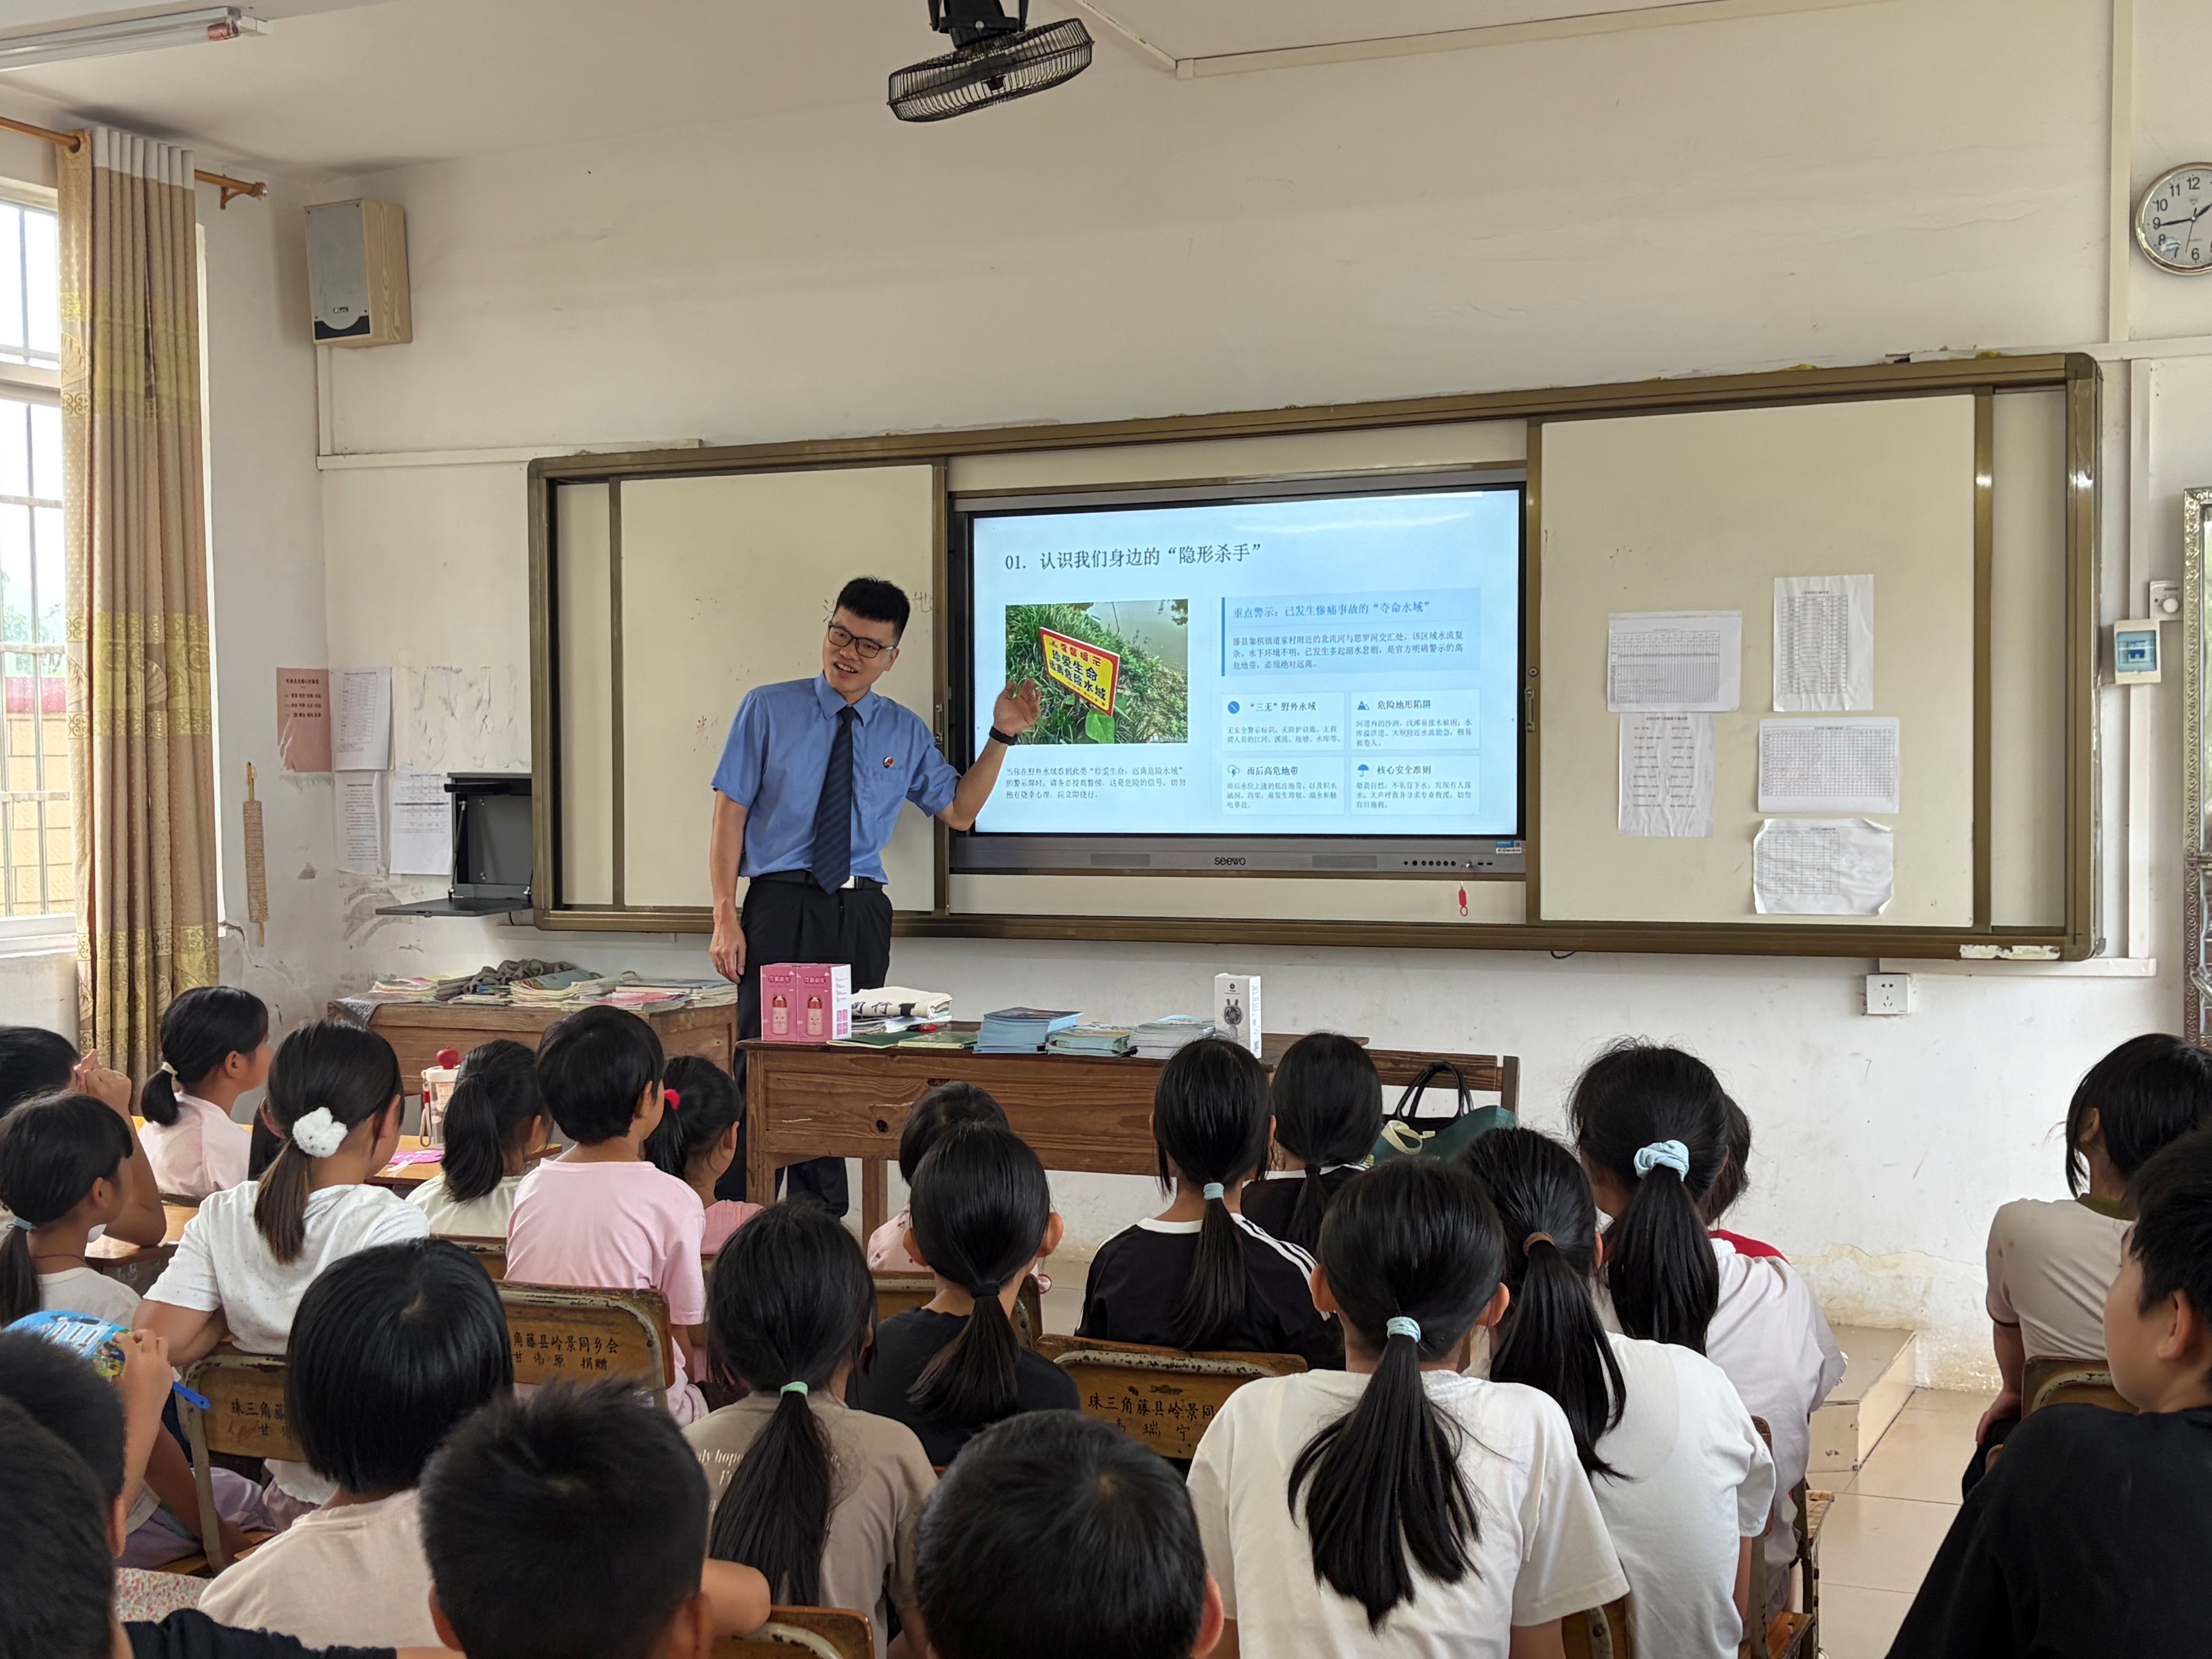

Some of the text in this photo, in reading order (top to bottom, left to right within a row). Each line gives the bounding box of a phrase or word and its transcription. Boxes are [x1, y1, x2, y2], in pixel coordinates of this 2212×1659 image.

[2187, 177, 2200, 190] 12
[2169, 184, 2180, 197] 11
[2152, 198, 2167, 212] 10
[2153, 217, 2161, 230] 9
[2191, 248, 2200, 261] 6
[1005, 543, 1261, 570] 01. 认识我们身边的“隐形杀手”
[1377, 700, 1431, 709] 危险地形陷阱
[1247, 766, 1298, 775] 雨后高危地带
[1377, 765, 1431, 775] 核心安全准则
[1214, 857, 1246, 866] seewo
